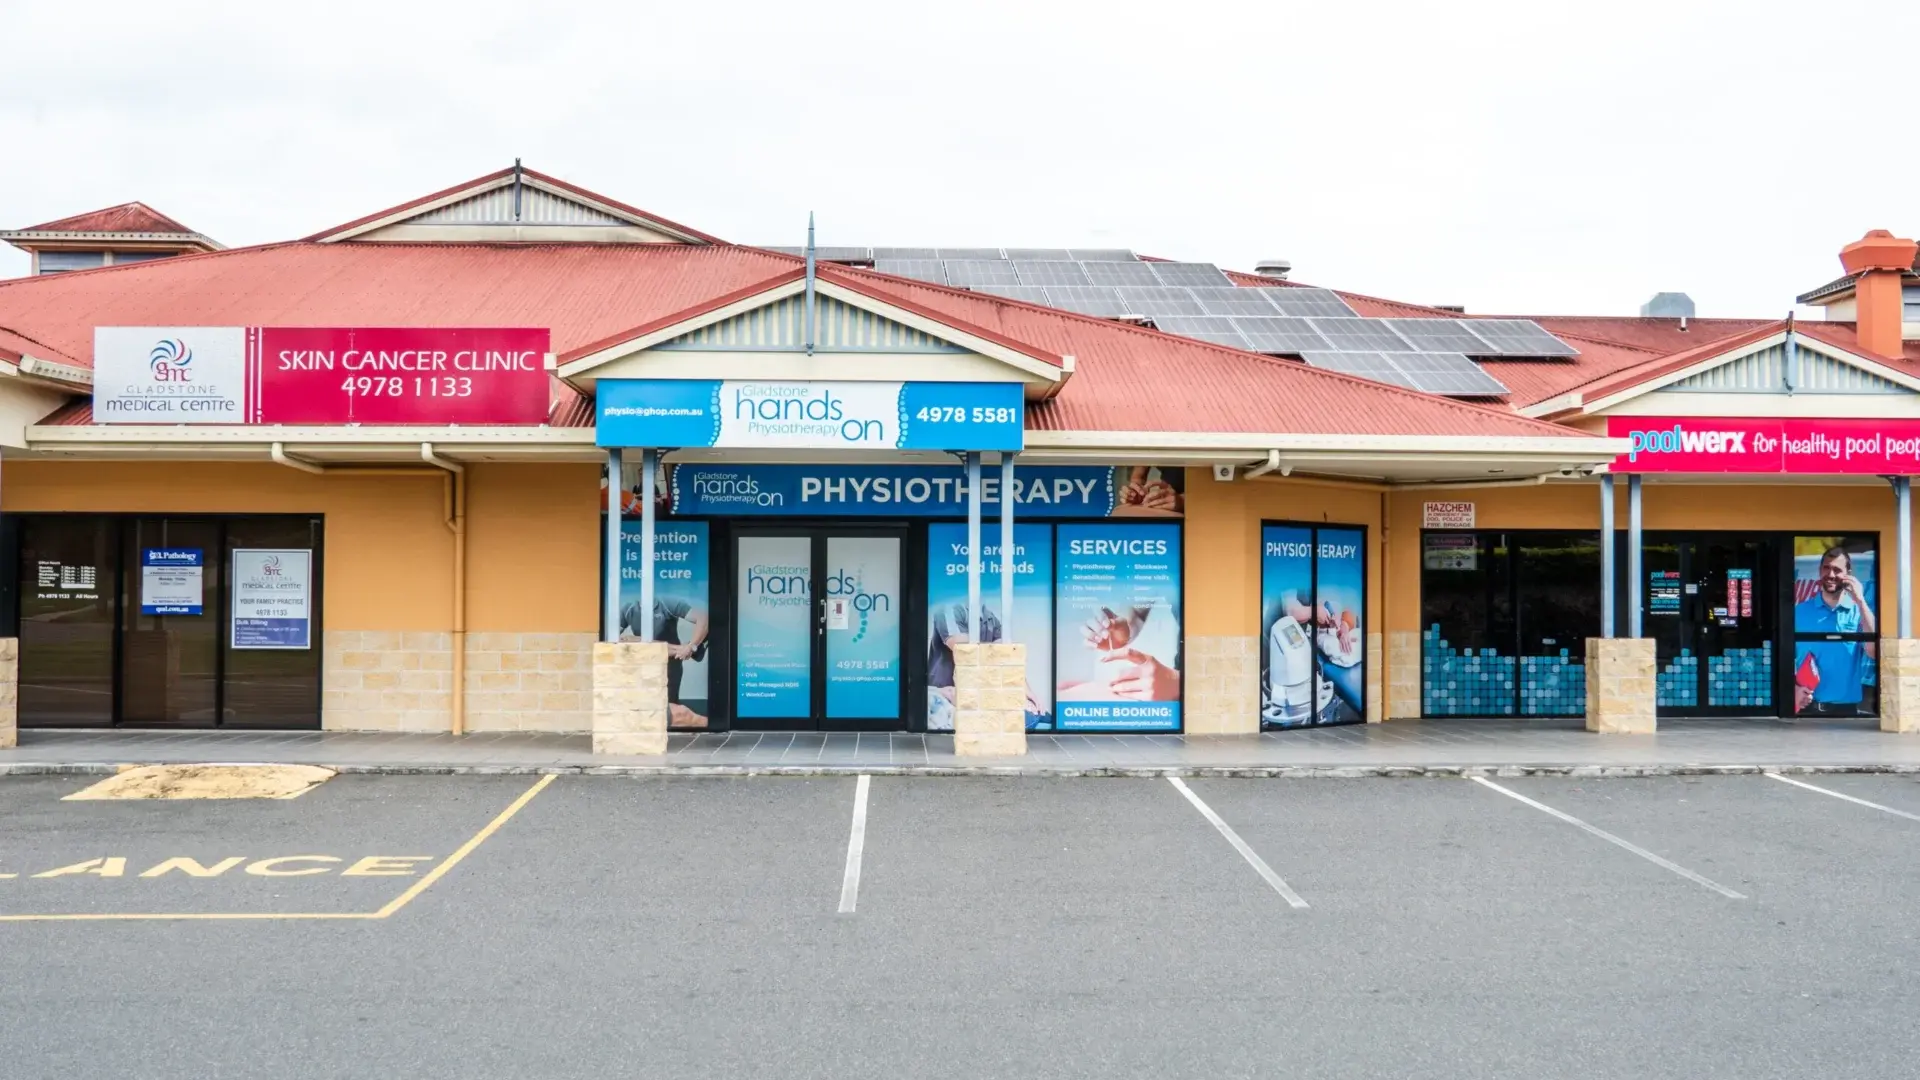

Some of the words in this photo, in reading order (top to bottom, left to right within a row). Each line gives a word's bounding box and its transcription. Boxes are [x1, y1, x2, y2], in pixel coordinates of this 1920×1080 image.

[278, 351, 335, 371] SKIN
[341, 350, 447, 371] CANCER
[453, 351, 536, 371] CLINIC
[126, 384, 217, 394] GLADSTONE
[340, 376, 404, 397] 4978
[413, 377, 473, 397] 1133
[741, 384, 809, 397] Gladstone
[735, 388, 843, 421] hands
[604, 406, 703, 417] physio@ghop.com.au
[916, 406, 966, 423] 4978
[971, 407, 1016, 423] 5581
[747, 420, 839, 437] Physiotherapy
[841, 419, 884, 441] on
[1629, 425, 1746, 463] poolwerx
[1752, 432, 1778, 453] for
[1782, 432, 1840, 459] healthy
[1845, 432, 1880, 461] pool
[698, 471, 738, 481] Gladstone
[693, 474, 760, 495] hands
[701, 494, 757, 504] Physiotherapy
[756, 490, 784, 507] on
[1426, 503, 1472, 513] HAZCHEM
[620, 531, 698, 544] Preention
[950, 543, 970, 556] Yo
[1069, 539, 1167, 556] SERVICES
[163, 551, 197, 561] Pathology
[626, 549, 638, 561] is
[653, 549, 689, 562] etter
[621, 566, 646, 579] tha
[659, 568, 693, 580] cure
[752, 564, 809, 575] Gladstone
[747, 567, 855, 596] hands
[853, 592, 889, 612] on
[836, 660, 863, 670] 4978
[745, 691, 777, 699] WorkCover
[1063, 706, 1110, 718] ONLINE
[1112, 706, 1173, 718] BOOKING:
